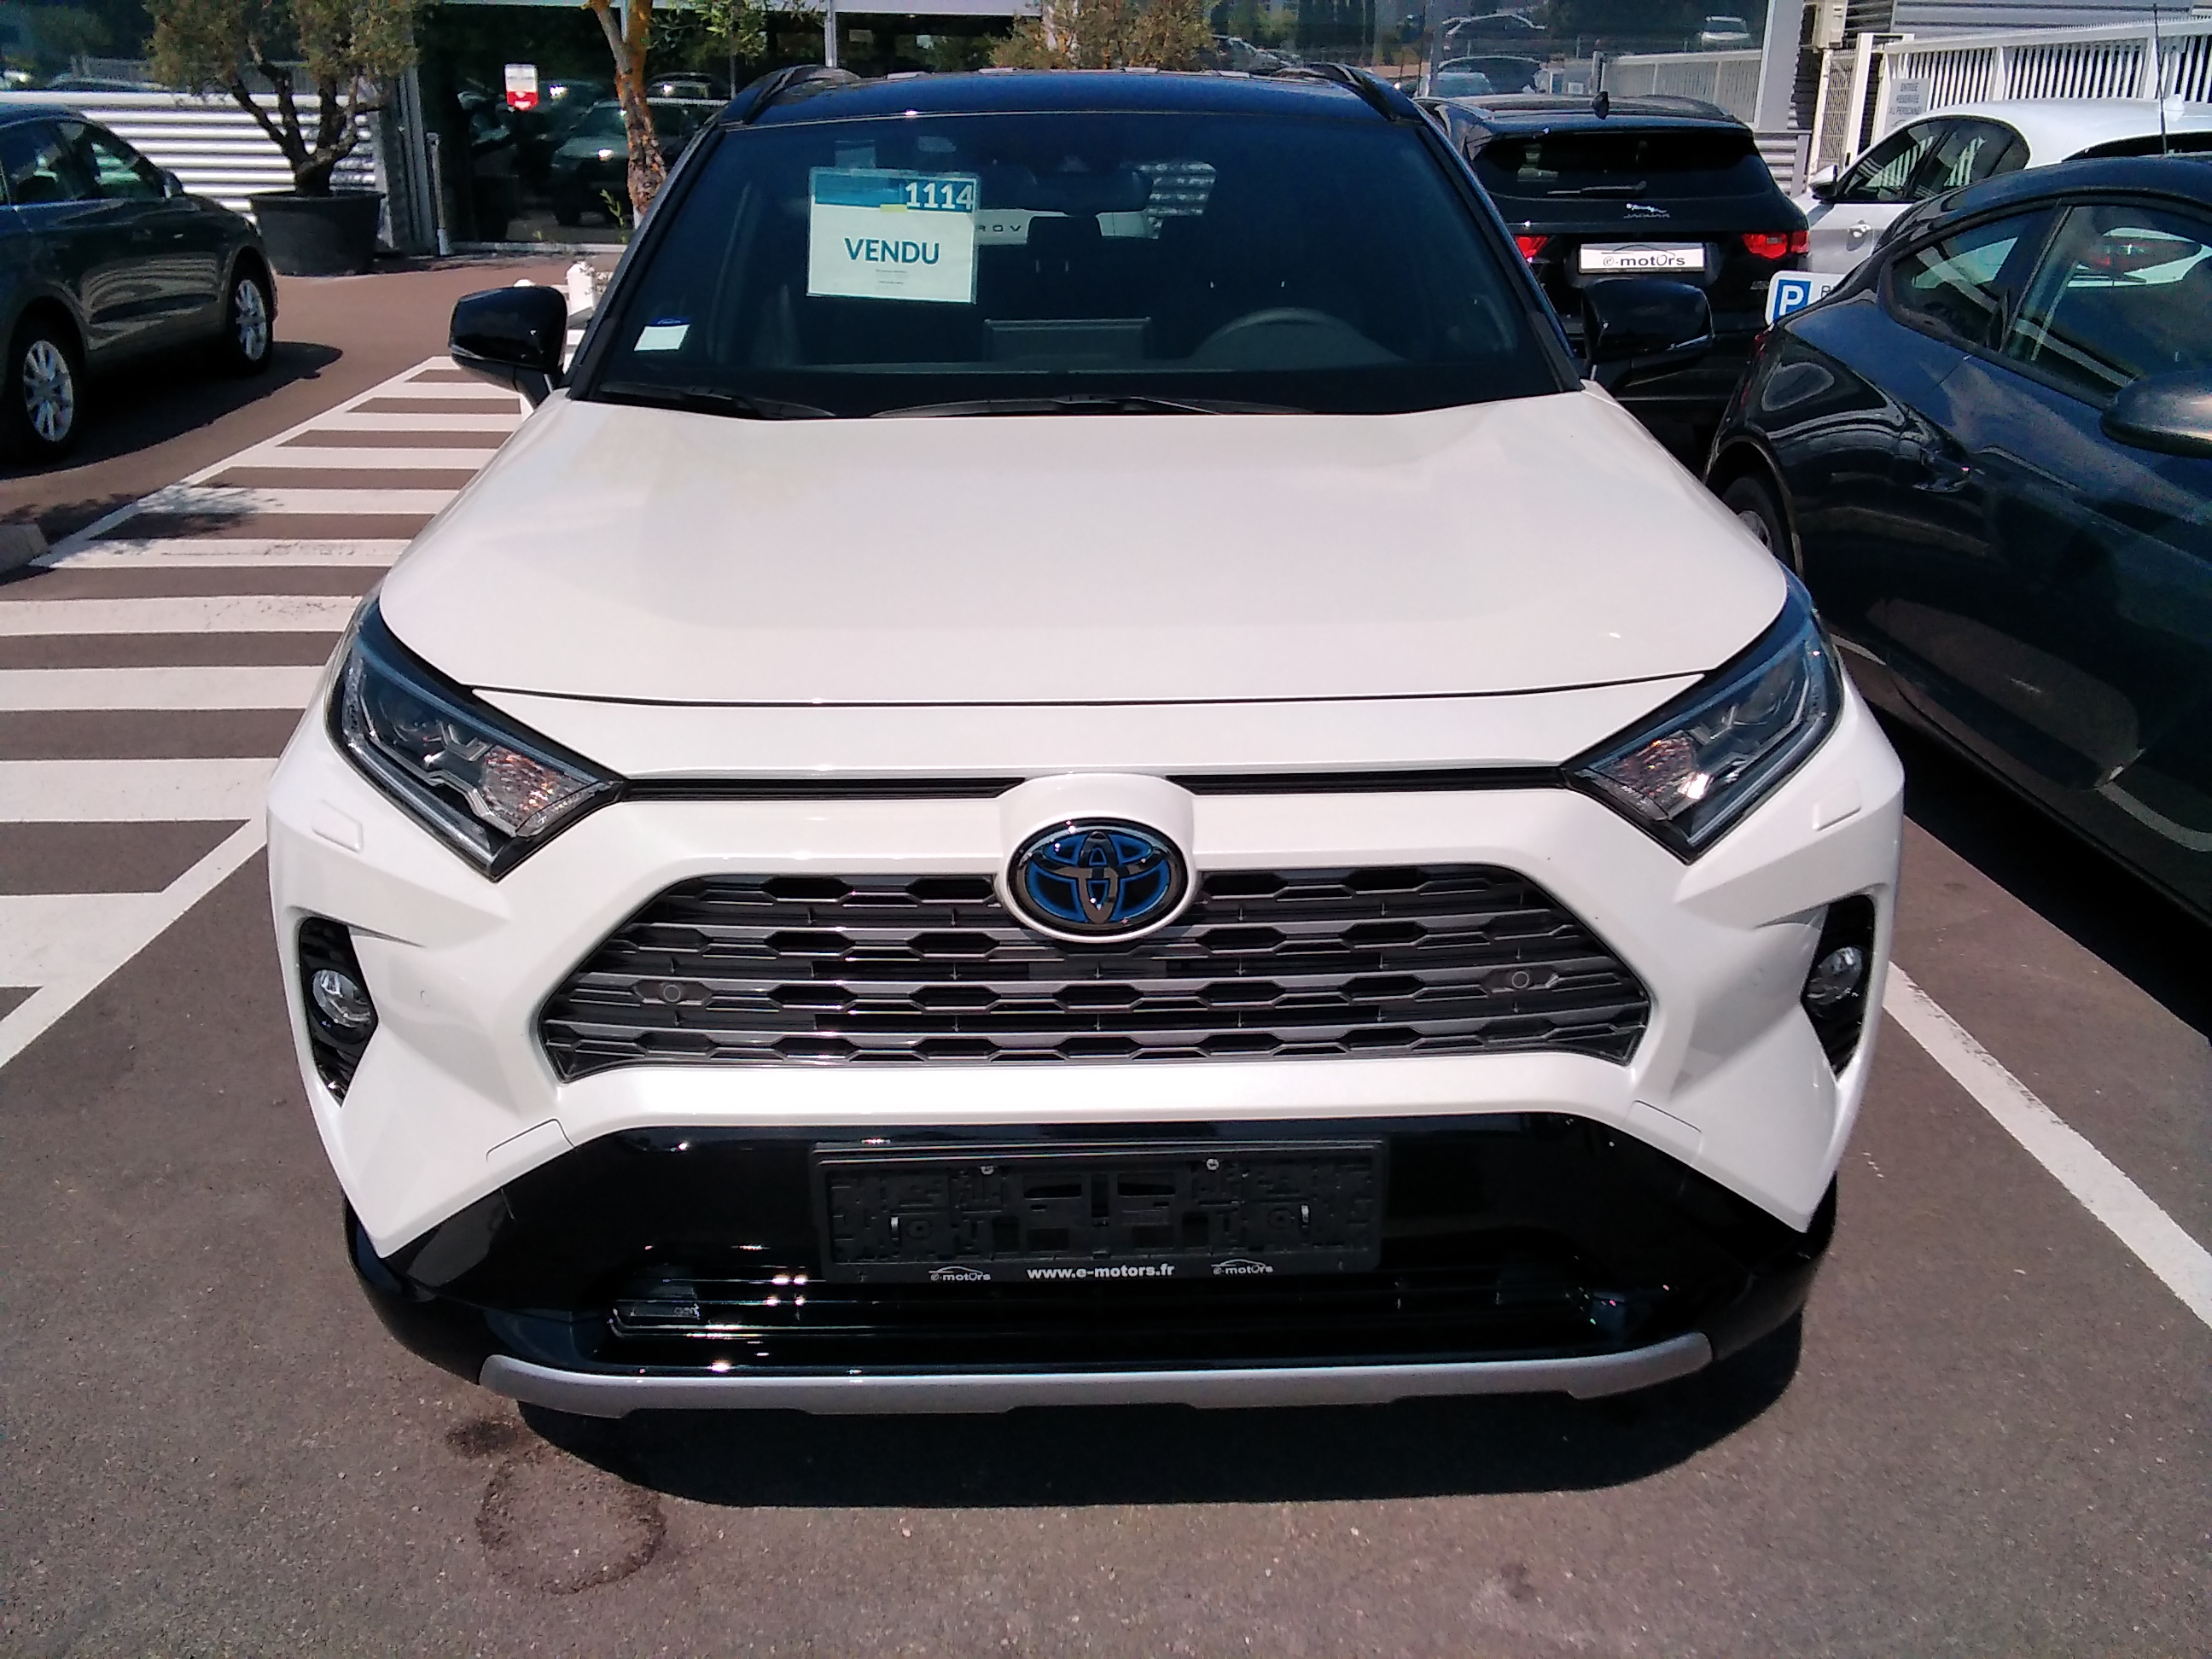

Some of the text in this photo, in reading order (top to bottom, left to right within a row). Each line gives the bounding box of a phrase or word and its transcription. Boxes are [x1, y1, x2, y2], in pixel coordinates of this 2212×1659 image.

[905, 182, 974, 210] 1114
[844, 237, 940, 265] VENDU
[1027, 1263, 1175, 1279] www.e-motors.fr
